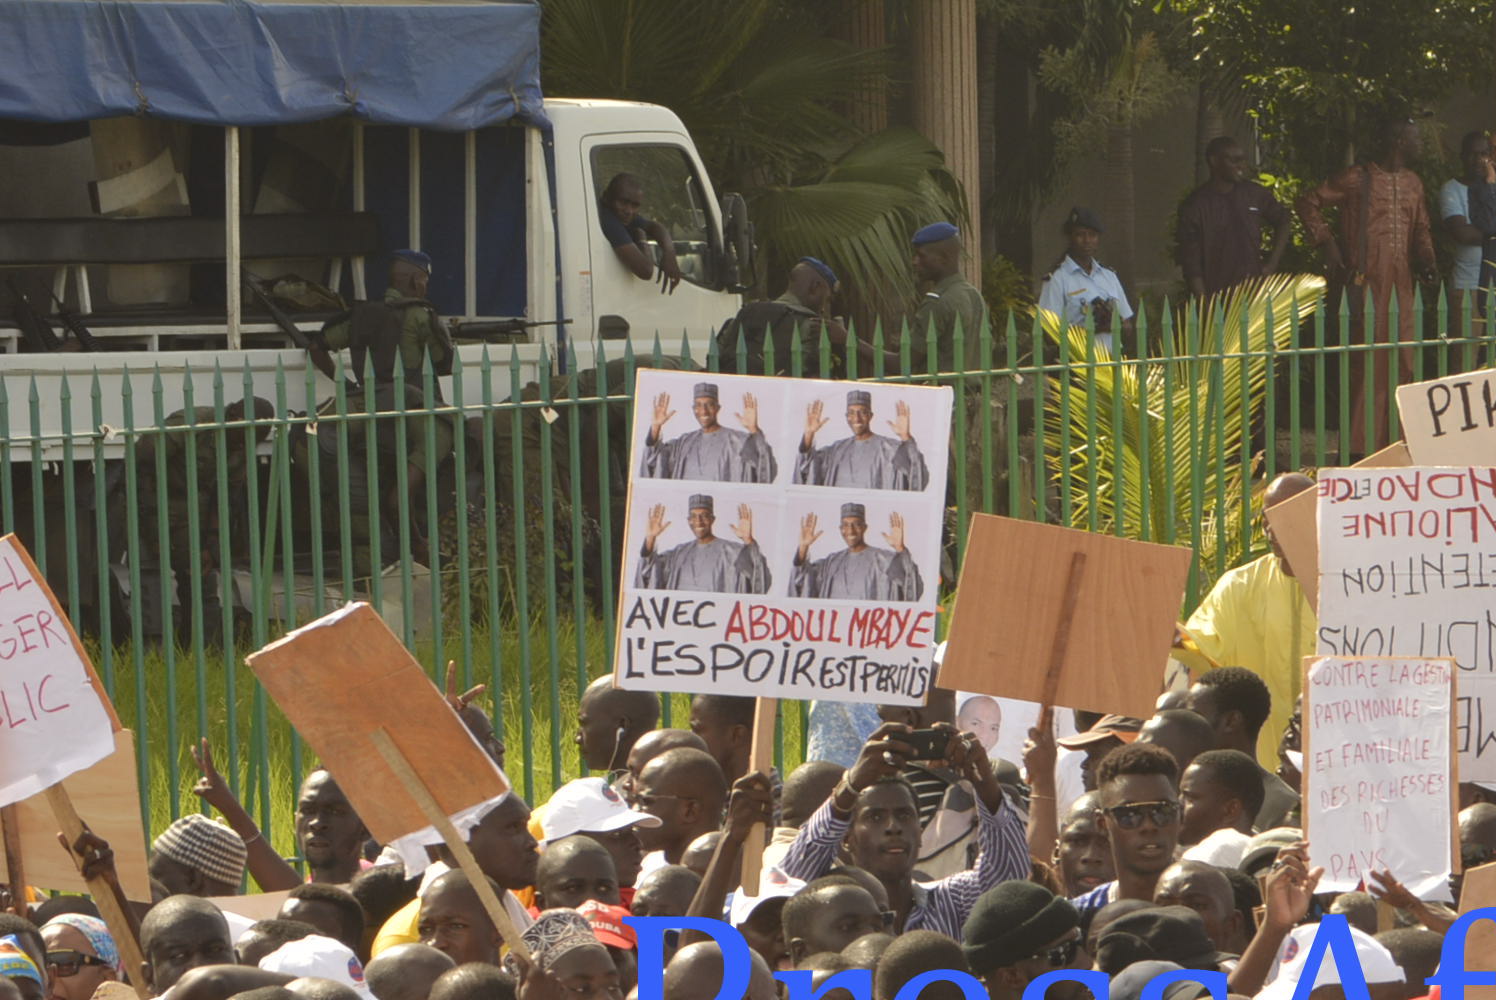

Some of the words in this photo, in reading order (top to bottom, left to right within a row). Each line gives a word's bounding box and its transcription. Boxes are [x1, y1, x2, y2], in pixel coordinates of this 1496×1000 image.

[625, 597, 716, 630] AVEC
[724, 601, 841, 644] ABDOUL
[848, 608, 935, 649] MBAYE
[1312, 661, 1379, 688] CONTRE
[1389, 666, 1410, 684] LA
[0, 674, 70, 729] LIC
[1314, 698, 1420, 728] PATRIMONIALE
[1316, 749, 1334, 772] ET
[1342, 738, 1430, 769] FAMILIALE
[1321, 785, 1348, 809] DES
[1358, 773, 1445, 803] RICHESSES
[1363, 808, 1390, 833] DU
